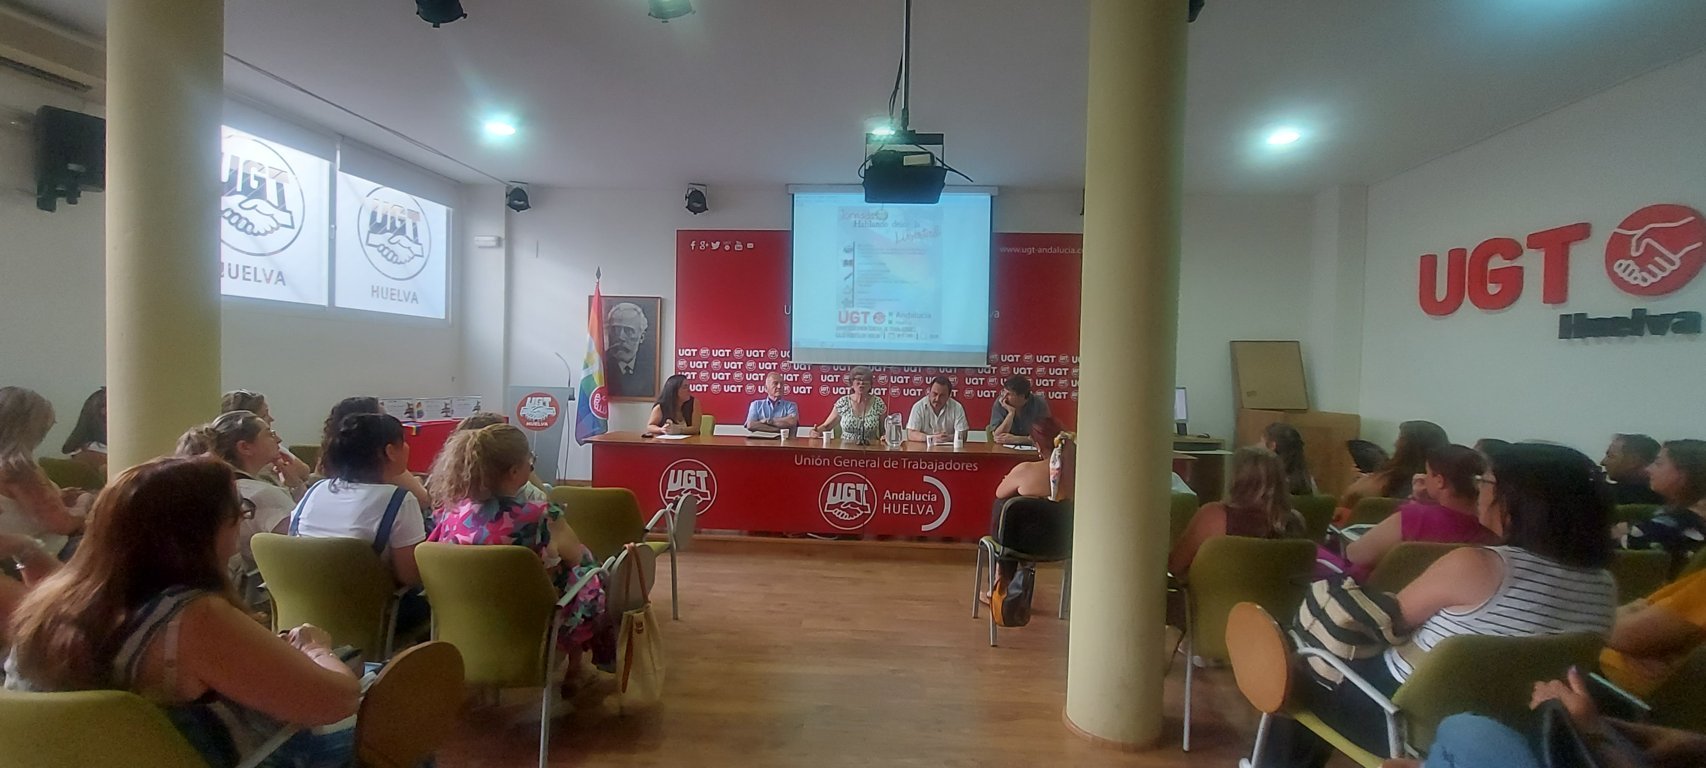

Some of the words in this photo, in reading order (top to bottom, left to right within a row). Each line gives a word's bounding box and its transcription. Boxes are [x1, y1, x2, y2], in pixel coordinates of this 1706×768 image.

[368, 198, 420, 243] UGT
[1419, 222, 1592, 316] UGT
[371, 284, 419, 304] HUELVA
[838, 311, 870, 324] UGT
[1559, 308, 1702, 339] Huelva
[712, 349, 731, 357] UGT
[746, 350, 765, 358] UGT
[1036, 355, 1056, 363] UGT
[758, 362, 778, 370] UGT
[1013, 367, 1033, 375] UGT
[712, 372, 731, 380] UGT
[746, 373, 765, 381] UGT
[891, 376, 910, 384] UGT
[1036, 379, 1055, 387] UGT
[689, 384, 708, 392] UGT
[724, 385, 743, 393] UGT
[793, 386, 812, 394] UGT
[903, 388, 922, 396] UGT
[977, 390, 997, 398] UGT
[526, 396, 552, 408] UGT
[794, 454, 830, 467] Unión
[833, 455, 880, 469] General
[883, 457, 899, 469] de
[901, 458, 979, 473] Trabajadores
[667, 469, 708, 491] UGT
[826, 482, 869, 505] UGT
[883, 490, 937, 502] Andalucía
[882, 503, 934, 515] HUELVA
